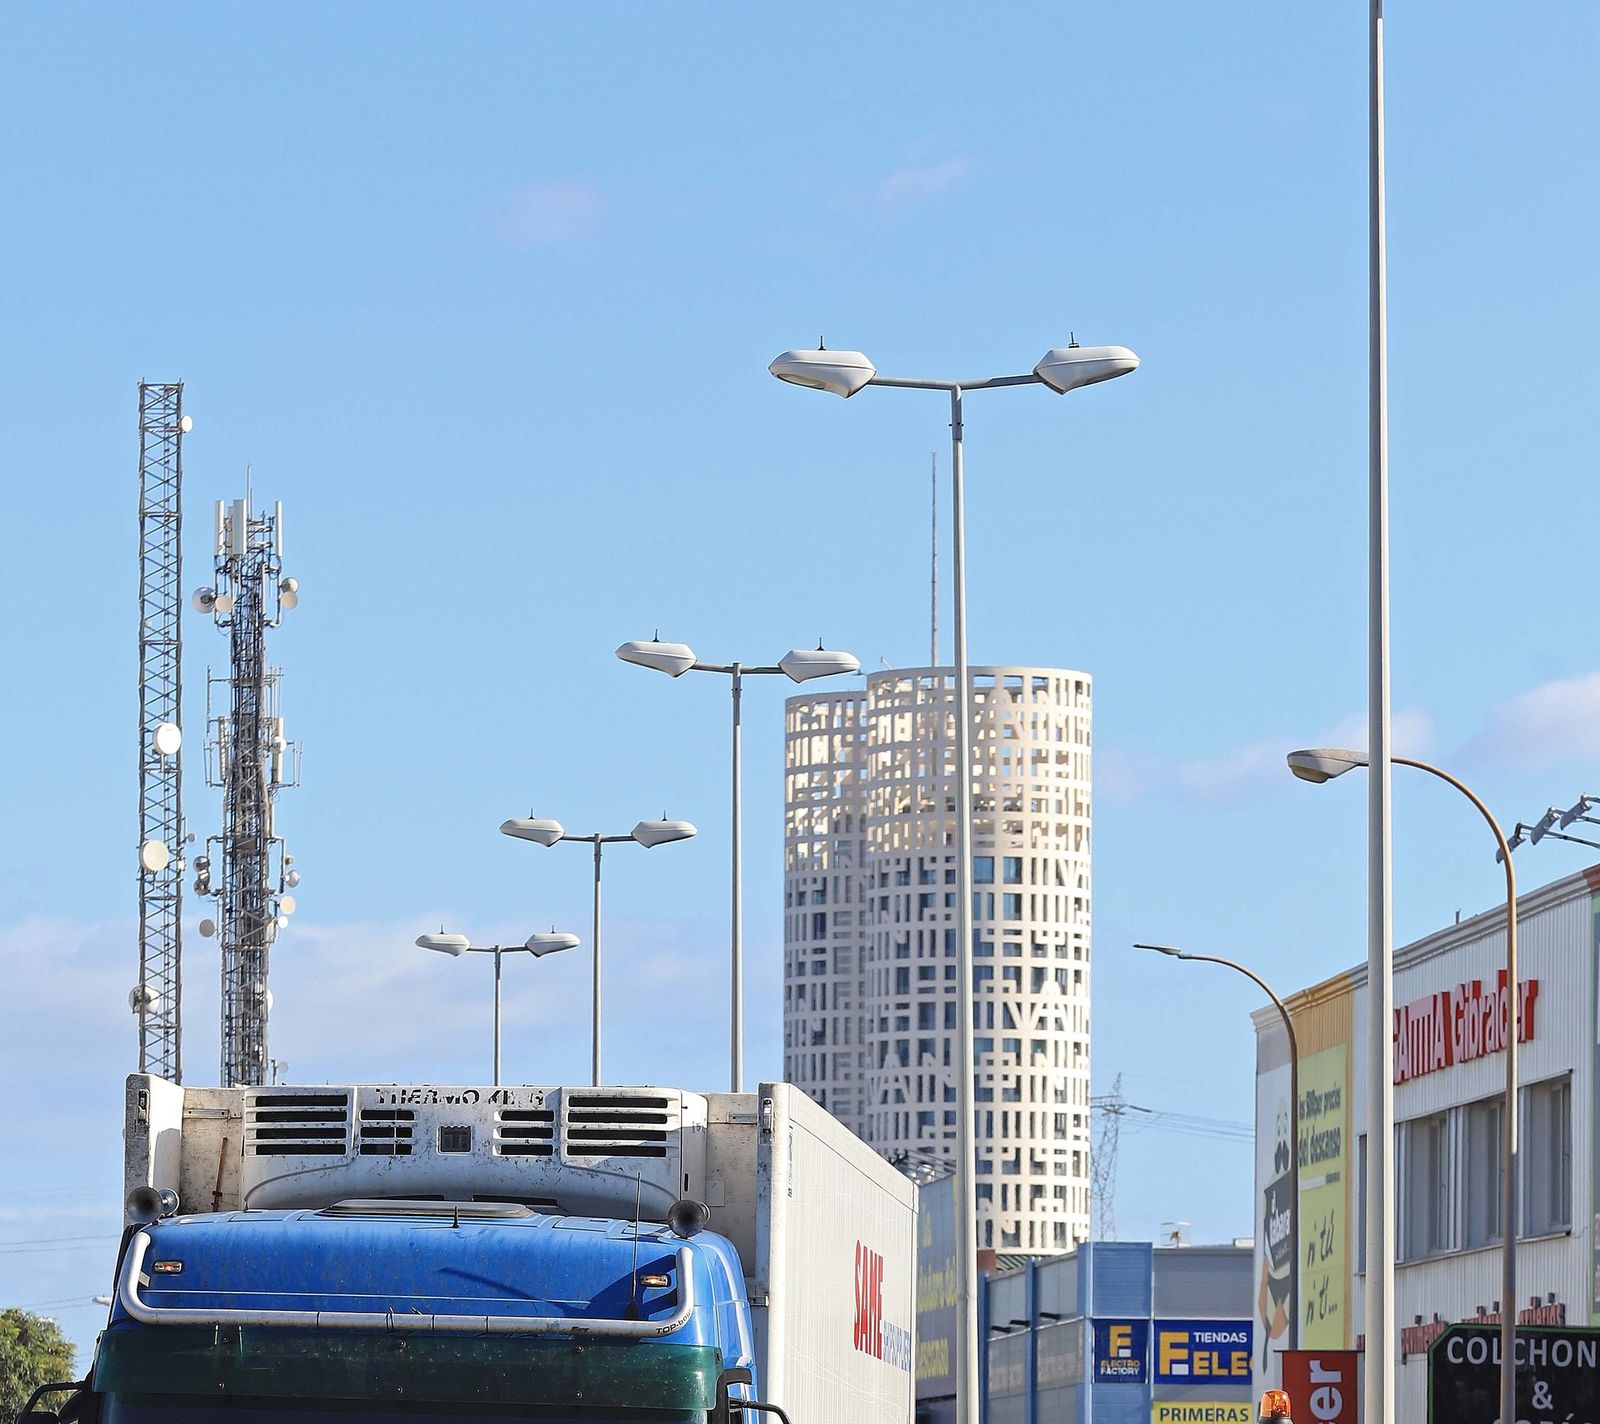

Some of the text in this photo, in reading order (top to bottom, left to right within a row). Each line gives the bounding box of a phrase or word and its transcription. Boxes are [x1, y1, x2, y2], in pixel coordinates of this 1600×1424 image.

[854, 1239, 884, 1360] SAME
[1193, 1332, 1248, 1343] TIENDAS
[1447, 1336, 1597, 1368] COLCHON
[1100, 1359, 1140, 1367] ELECTRO
[1100, 1367, 1140, 1375] FACTORY
[1193, 1351, 1254, 1376] ELE
[1532, 1381, 1553, 1409] &
[1160, 1408, 1249, 1422] PRIMERAS
